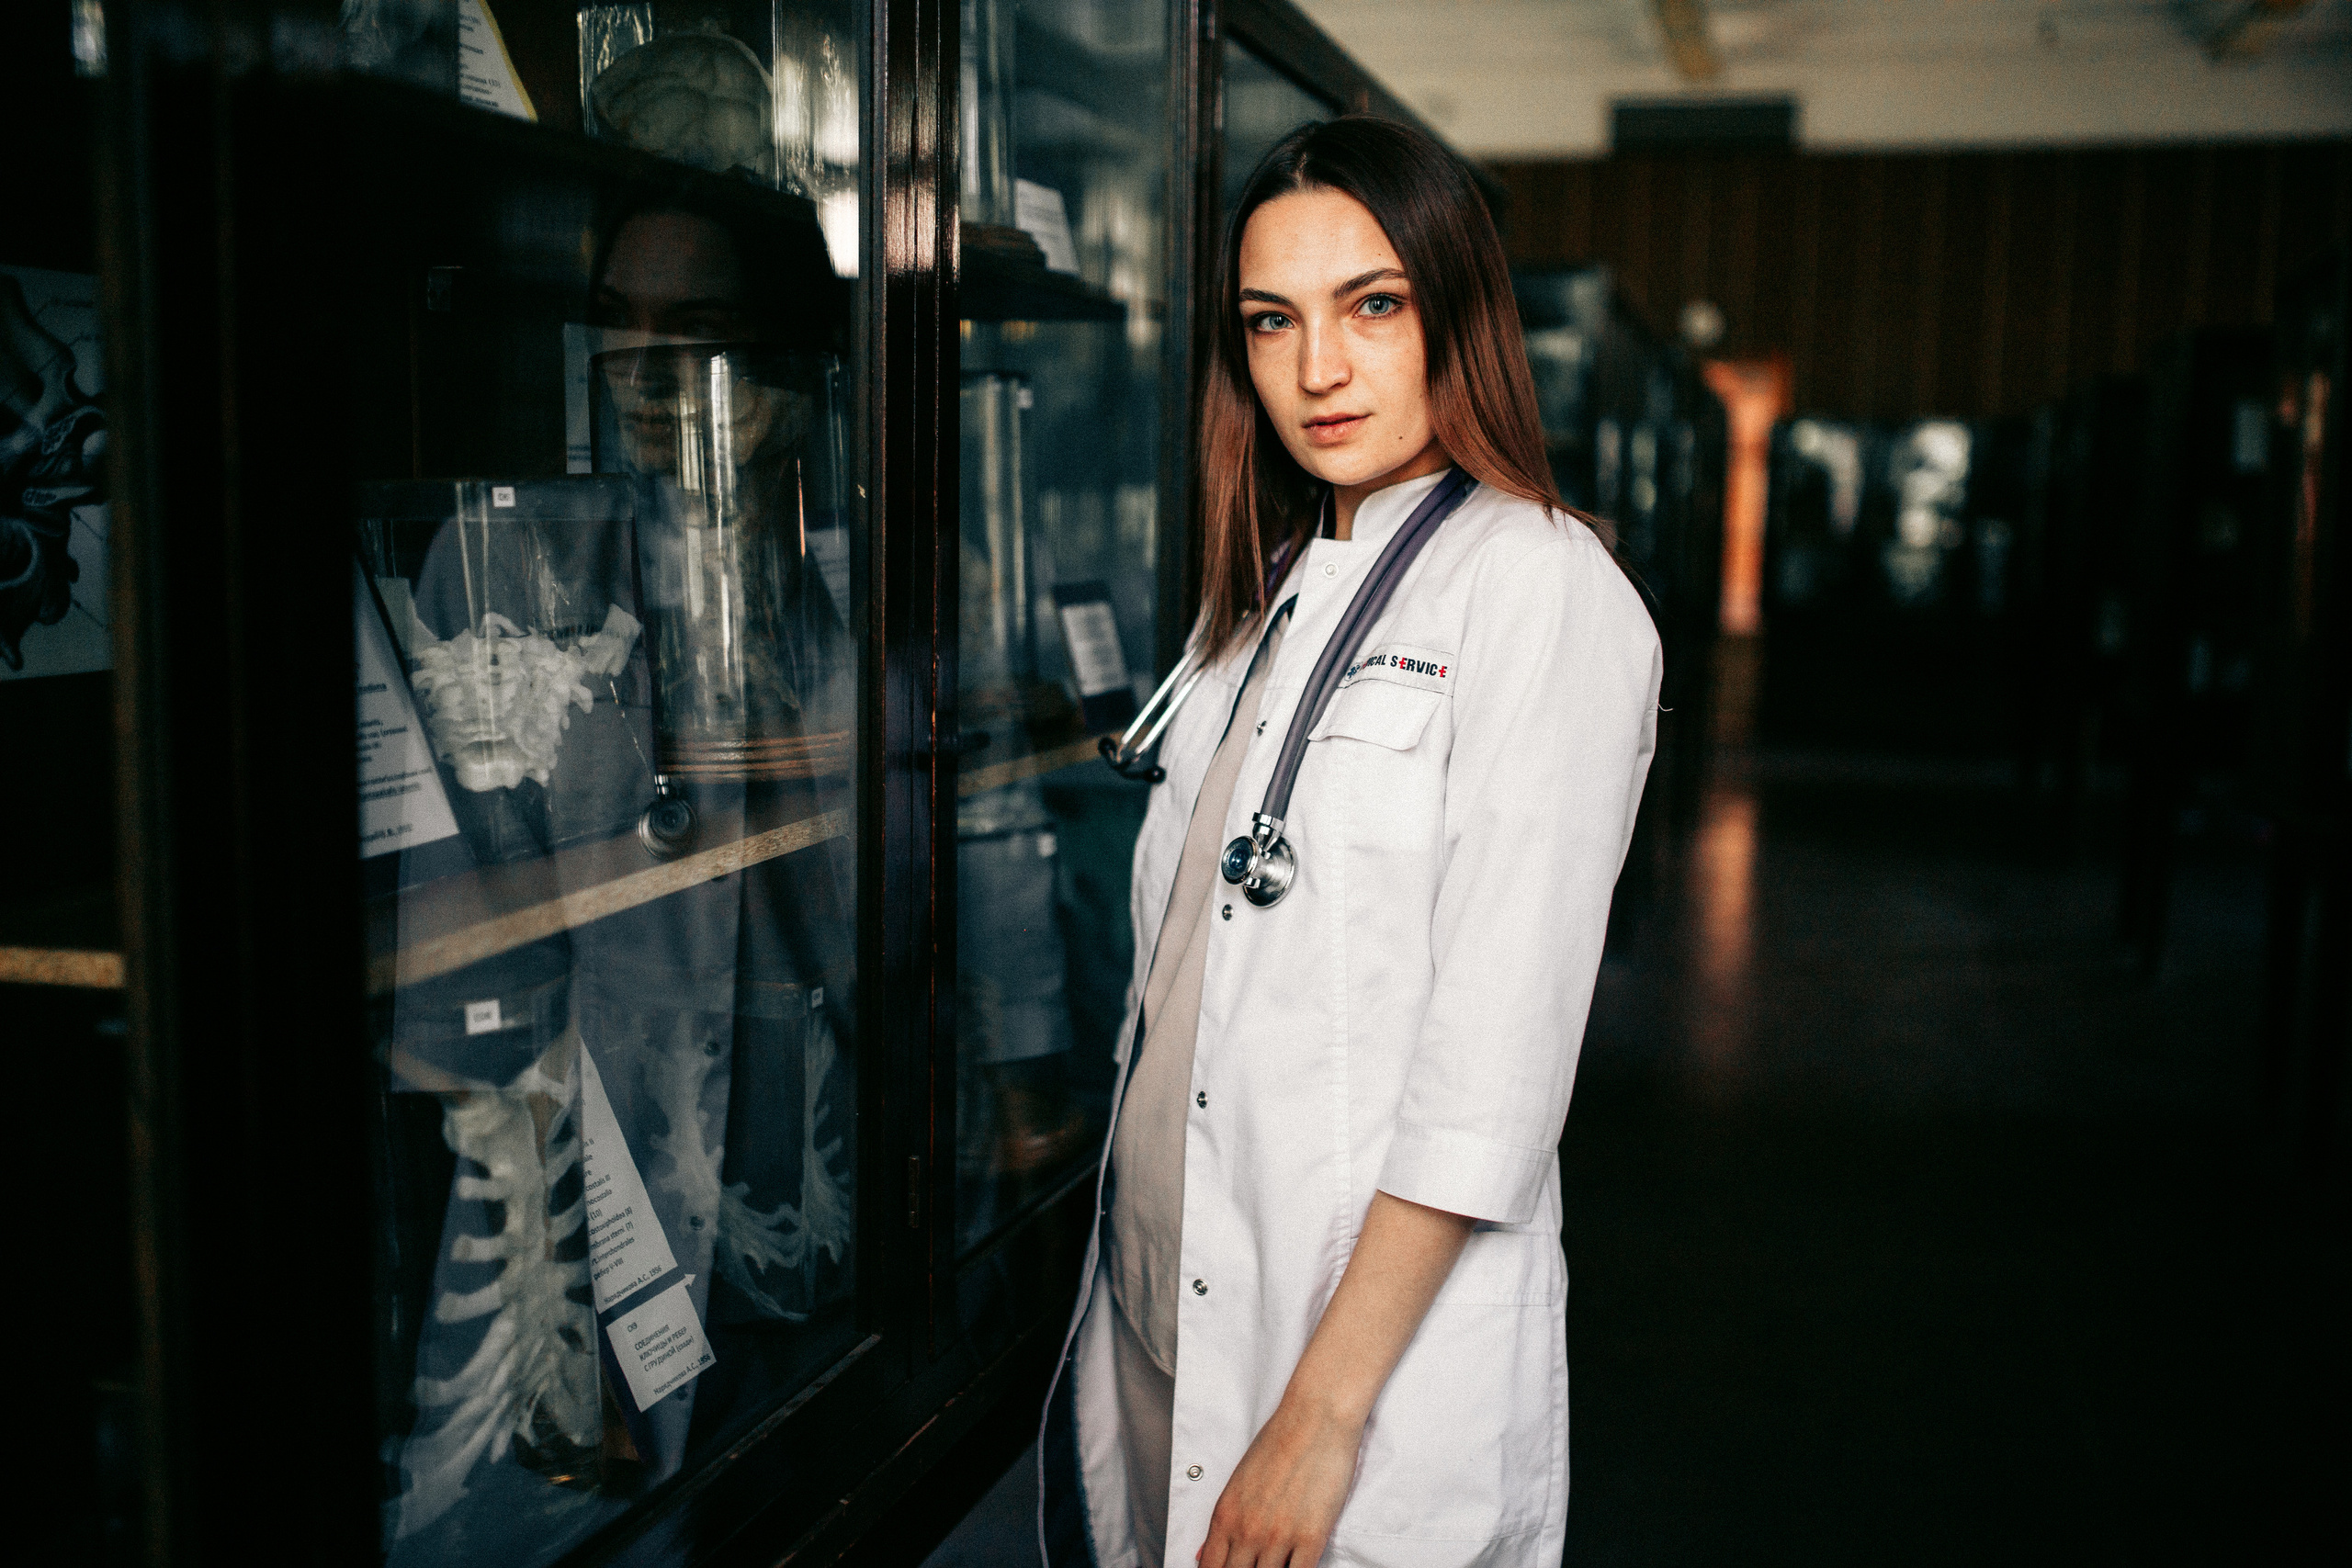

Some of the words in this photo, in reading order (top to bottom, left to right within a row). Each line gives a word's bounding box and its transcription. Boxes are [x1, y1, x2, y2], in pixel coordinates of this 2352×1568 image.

[1390, 655, 1448, 678] SERVICE
[635, 1325, 669, 1350] СОЕДИНЕНИЯ
[639, 1340, 668, 1361] КЛЮЧИЦЫ
[672, 1326, 687, 1339] РЕБЕР
[648, 1346, 675, 1370] ГРУДИНОЙ
